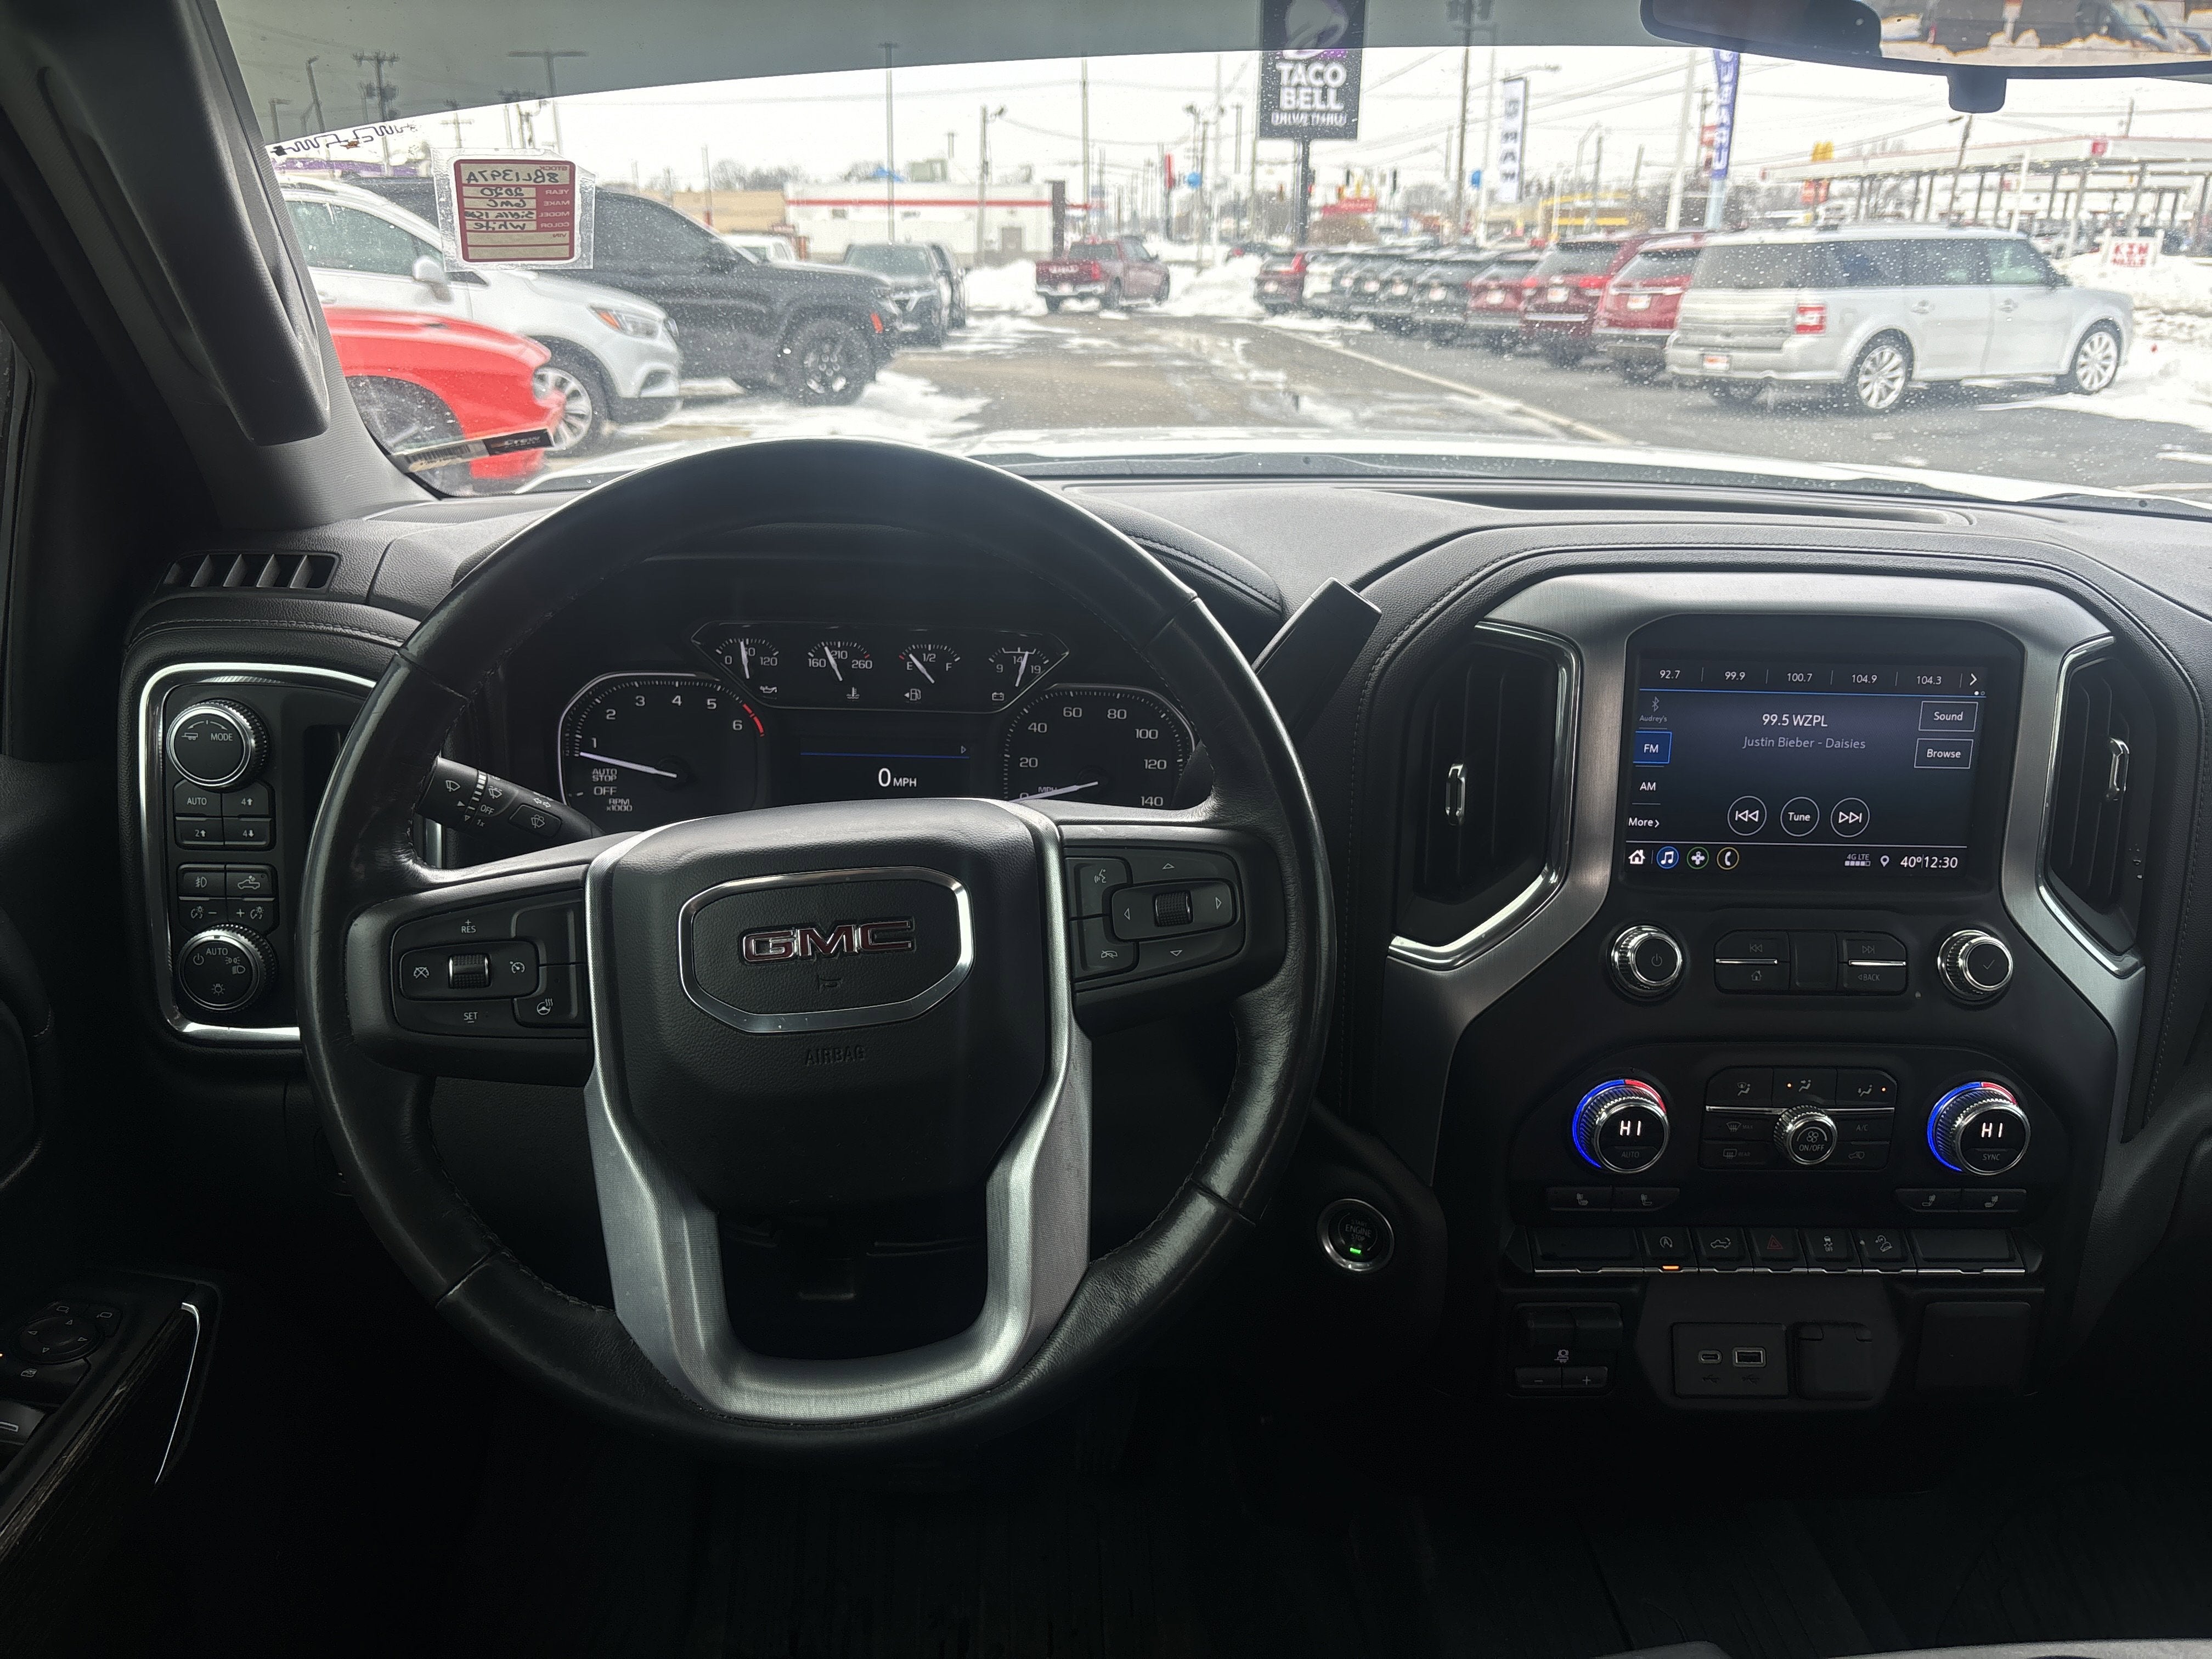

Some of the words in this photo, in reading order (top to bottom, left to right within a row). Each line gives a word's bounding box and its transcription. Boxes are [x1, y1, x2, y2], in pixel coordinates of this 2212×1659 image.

[1276, 62, 1347, 88] TACO
[1279, 87, 1344, 111] BELL
[831, 650, 848, 659] 210
[923, 653, 936, 663] 1/2
[725, 656, 732, 665] 0
[759, 657, 778, 666] 120
[808, 658, 826, 668] 160
[851, 660, 873, 669] 260
[907, 662, 913, 671] E
[946, 662, 952, 672] F
[996, 664, 1003, 673] 9
[1030, 665, 1041, 674] 19
[1660, 670, 1680, 679] 92.7
[1724, 672, 1745, 681] 99.9
[1787, 673, 1813, 682] 100.7
[1852, 674, 1877, 684] 104.9
[1916, 675, 1942, 685] 104.3
[635, 695, 646, 707] 3
[672, 695, 682, 706] 4
[707, 698, 717, 710] 5
[606, 709, 617, 720] 2
[1063, 708, 1082, 718] 60
[1107, 709, 1127, 719] 80
[1933, 712, 1963, 721] Sound
[1639, 715, 1668, 724] Audrey's
[1762, 714, 1789, 726] 99.5
[1793, 714, 1828, 727] WZPL
[732, 720, 743, 731] 6
[1028, 723, 1047, 733] 40
[210, 732, 233, 742] MODE
[1135, 729, 1158, 740] 100
[591, 738, 597, 748] 1
[1742, 736, 1775, 749] Justin
[1778, 737, 1814, 748] Bieber
[1825, 738, 1866, 749] Daisies
[1644, 744, 1659, 754] FM
[1927, 749, 1961, 758] Browse
[1019, 758, 1038, 768] 20
[1144, 759, 1167, 770] 120
[878, 768, 891, 788] 0
[893, 777, 917, 788] MPH
[594, 787, 617, 796] OFF
[1640, 782, 1656, 792] AM
[187, 797, 207, 806] AUTO
[241, 797, 246, 806] 4
[1141, 796, 1163, 806] 140
[481, 804, 495, 815] OFF
[1628, 817, 1653, 827] More
[1788, 812, 1810, 822] Tune
[195, 830, 200, 838] 2
[242, 830, 248, 838] 4
[1925, 857, 1958, 868] 12:30
[461, 926, 476, 934] RES
[743, 920, 912, 962] GMC
[206, 947, 228, 956] AUTO
[1863, 973, 1880, 981] BACK
[464, 1012, 478, 1020] SET
[805, 1045, 865, 1066] AIRBAG
[1620, 1120, 1641, 1137] HI
[1856, 1124, 1869, 1132] A/C
[1981, 1122, 2004, 1138] HI
[1799, 1144, 1825, 1152] ON/OFF
[1983, 1153, 2001, 1161] SYNC
[1345, 1224, 1372, 1238] ENGINE
